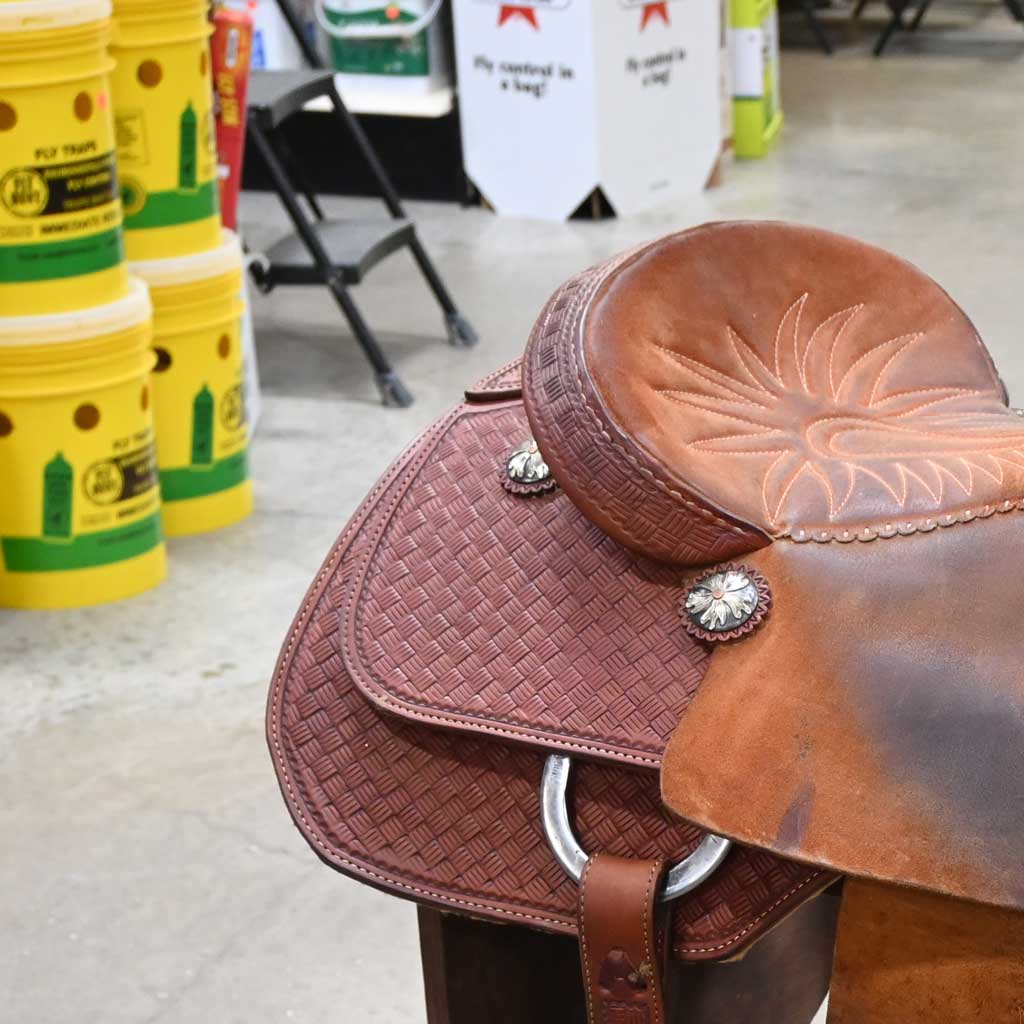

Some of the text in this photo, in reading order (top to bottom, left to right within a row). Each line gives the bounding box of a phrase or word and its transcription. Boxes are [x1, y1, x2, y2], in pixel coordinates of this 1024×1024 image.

[474, 55, 573, 78] Fly control in
